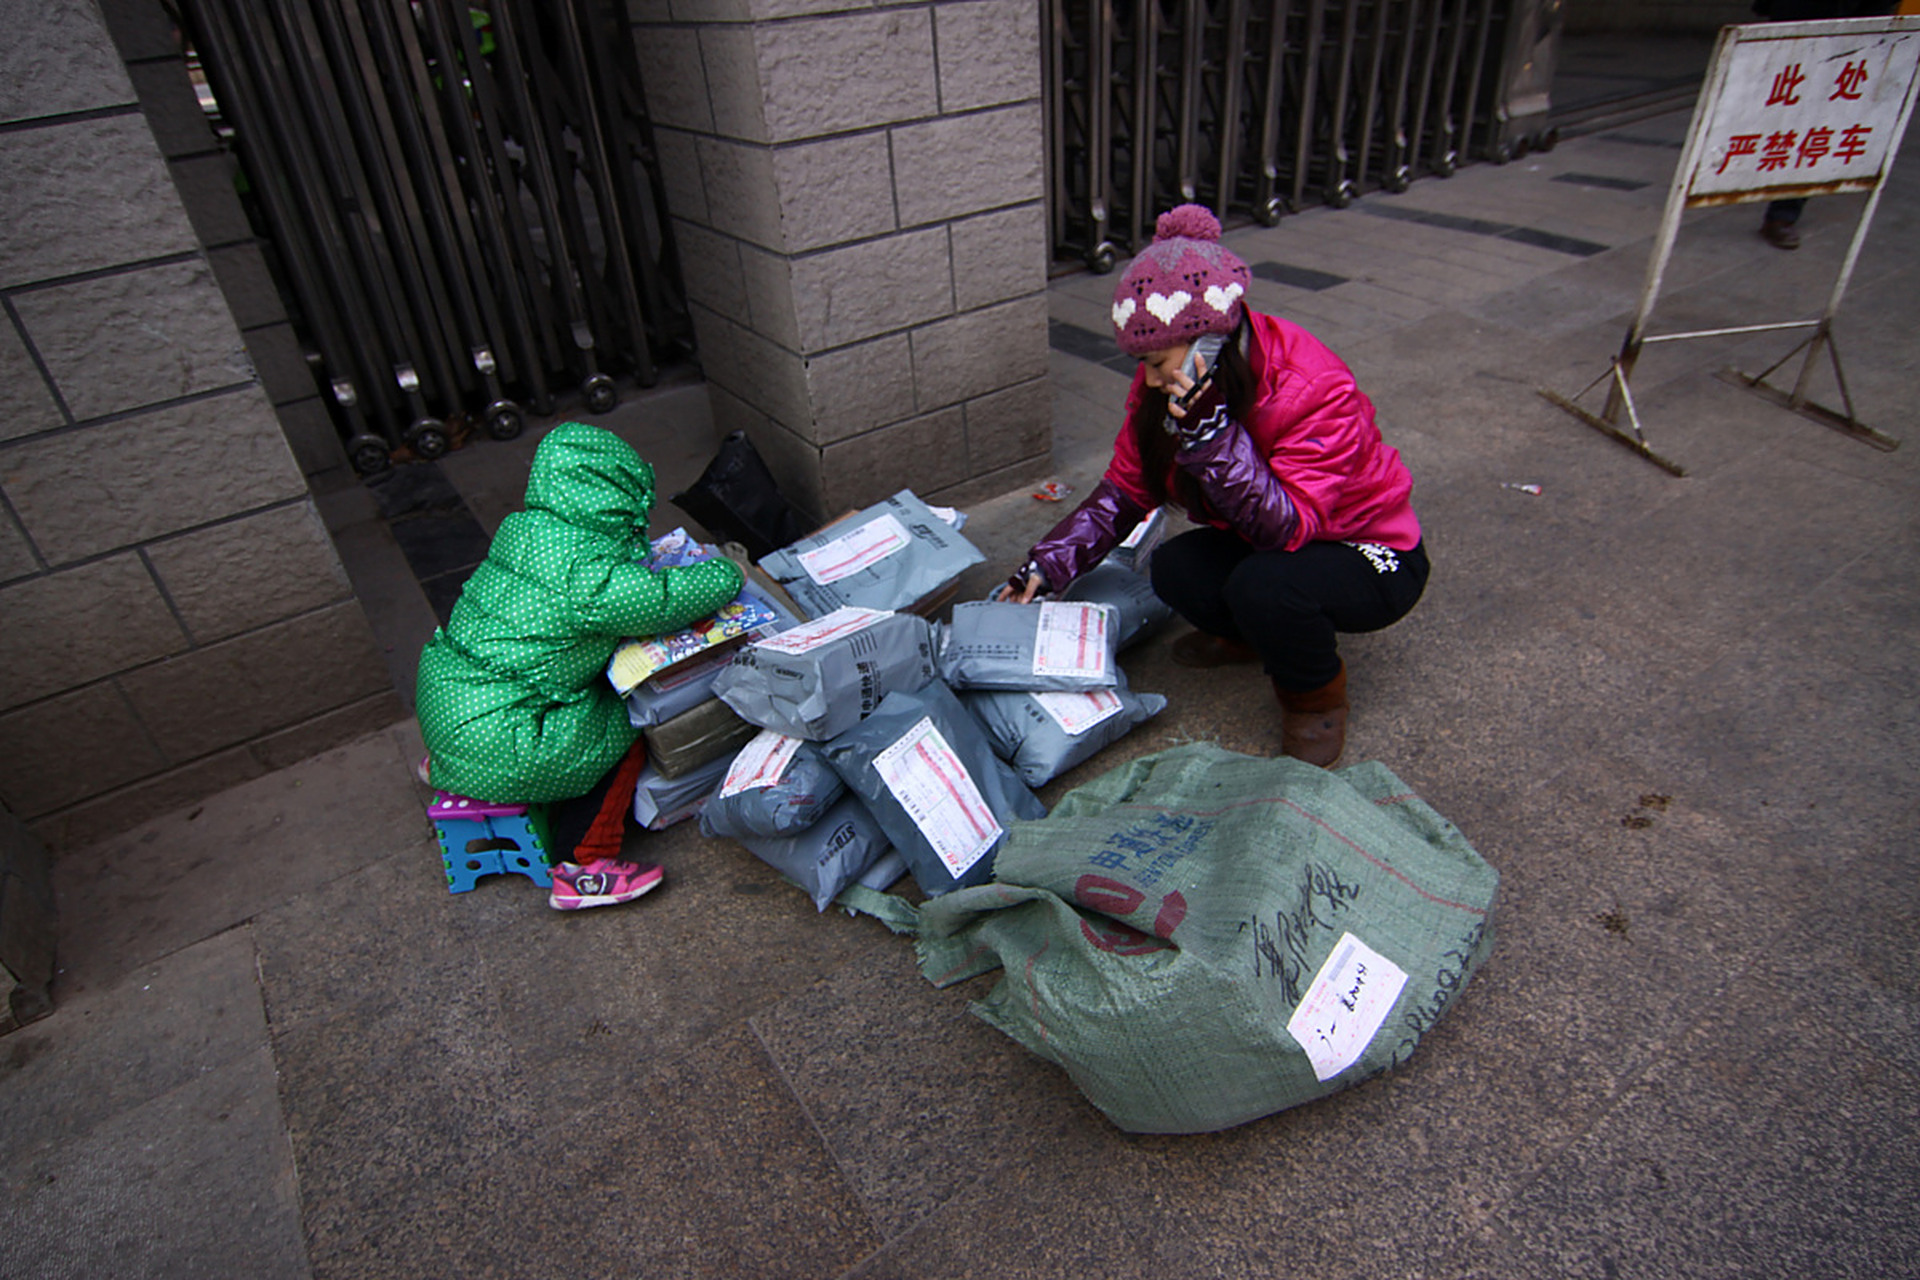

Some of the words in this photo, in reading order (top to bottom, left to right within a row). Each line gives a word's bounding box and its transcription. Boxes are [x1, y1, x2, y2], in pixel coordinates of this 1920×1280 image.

[1765, 59, 1868, 107] 此处
[1715, 124, 1873, 175] 严禁停车
